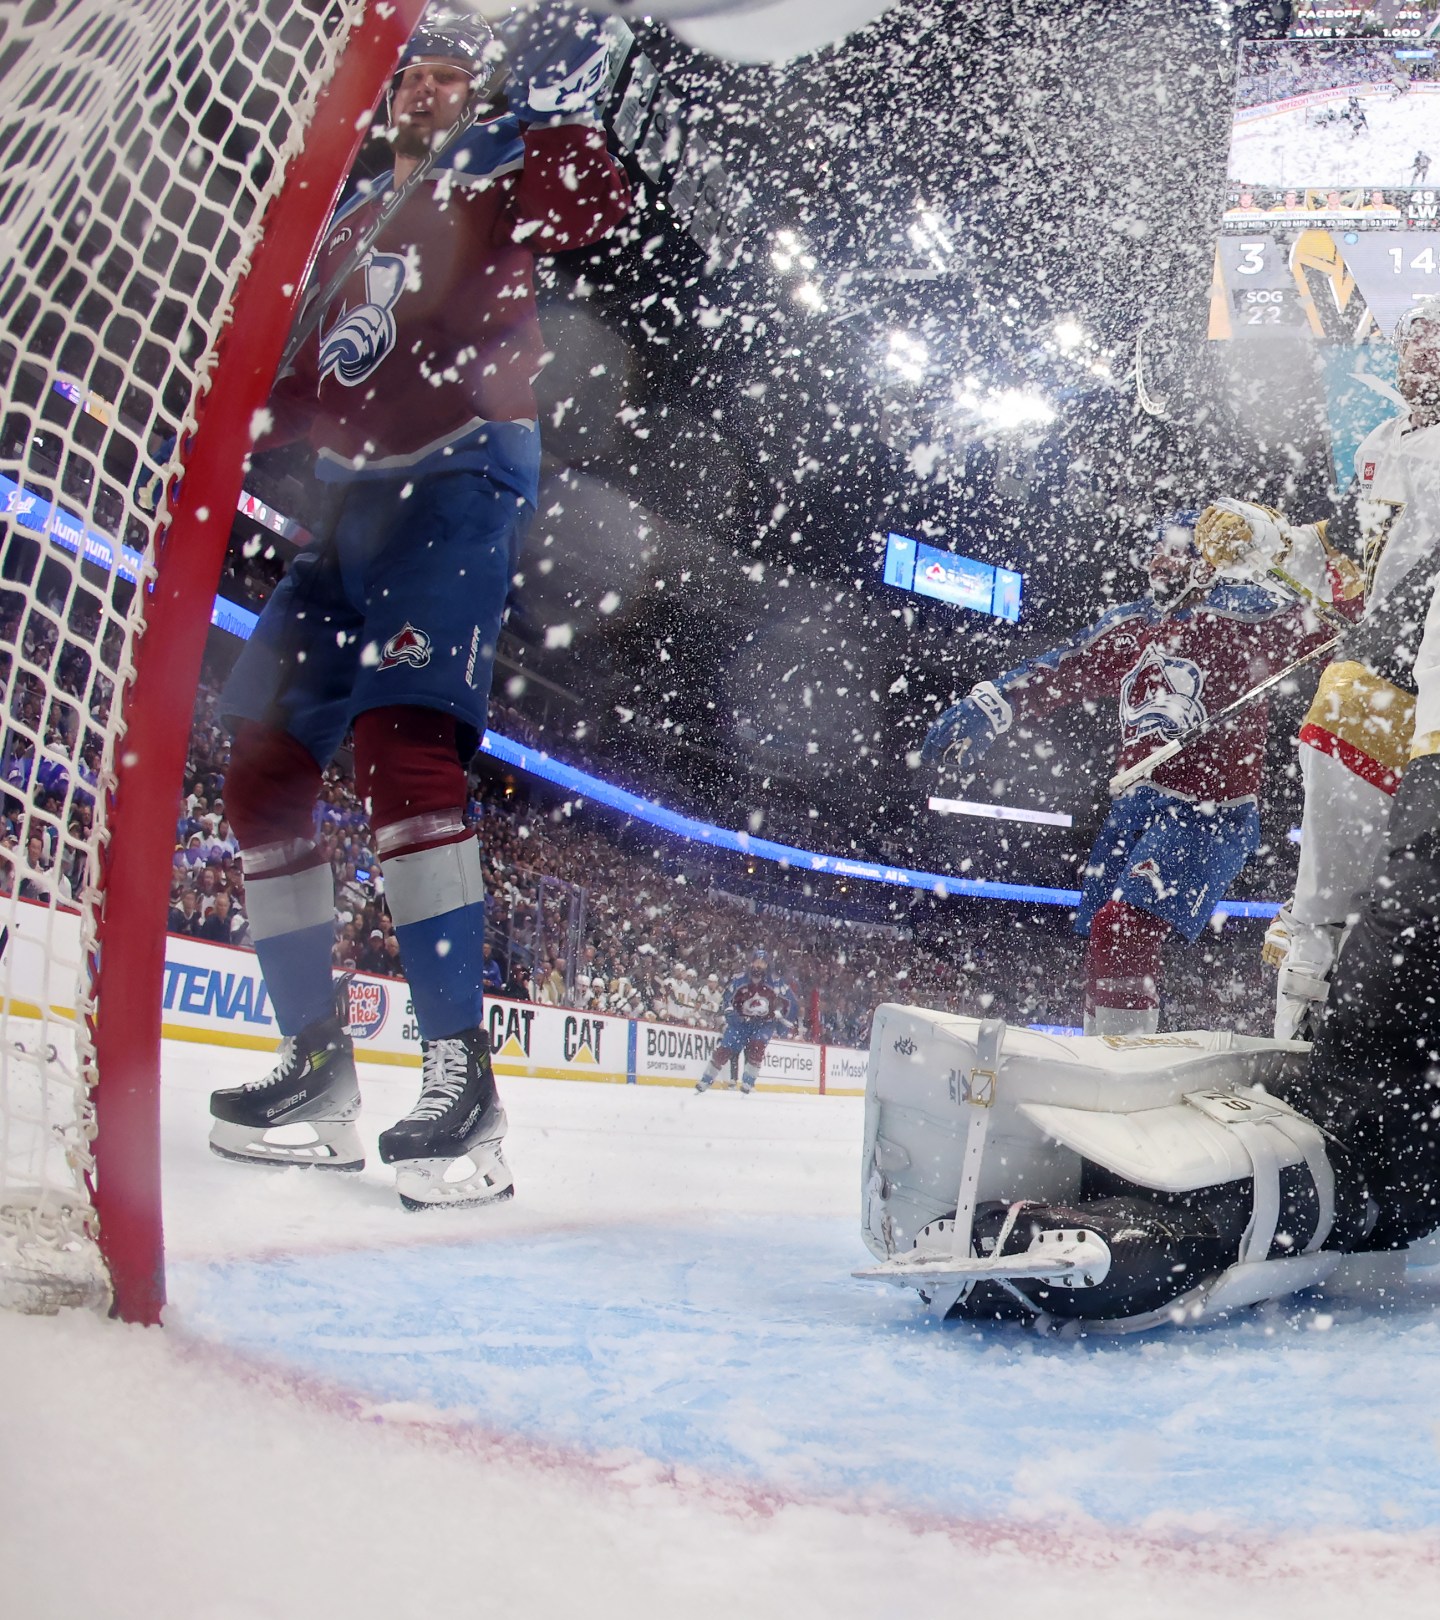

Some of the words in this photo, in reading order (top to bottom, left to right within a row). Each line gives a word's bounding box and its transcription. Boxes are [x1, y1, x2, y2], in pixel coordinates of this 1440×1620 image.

[1297, 9, 1362, 19] FACEOFF
[1365, 9, 1375, 18] %
[1394, 10, 1422, 20] .510
[1295, 28, 1332, 37] SAVE
[1334, 28, 1346, 37] %
[1382, 28, 1421, 37] 1.000
[1348, 85, 1391, 95] DISVER
[1410, 190, 1435, 204] 49
[1408, 204, 1438, 219] LW
[1382, 219, 1399, 227] MPH
[1236, 242, 1267, 275] 3
[1245, 290, 1284, 304] SOG
[1247, 305, 1281, 326] 22
[259, 507, 267, 521] 0
[349, 984, 381, 1003] rsey
[489, 1004, 535, 1058] CAT
[564, 1015, 605, 1065] CAT
[646, 1060, 668, 1071] SPORTS
[669, 1062, 686, 1072] DRINK
